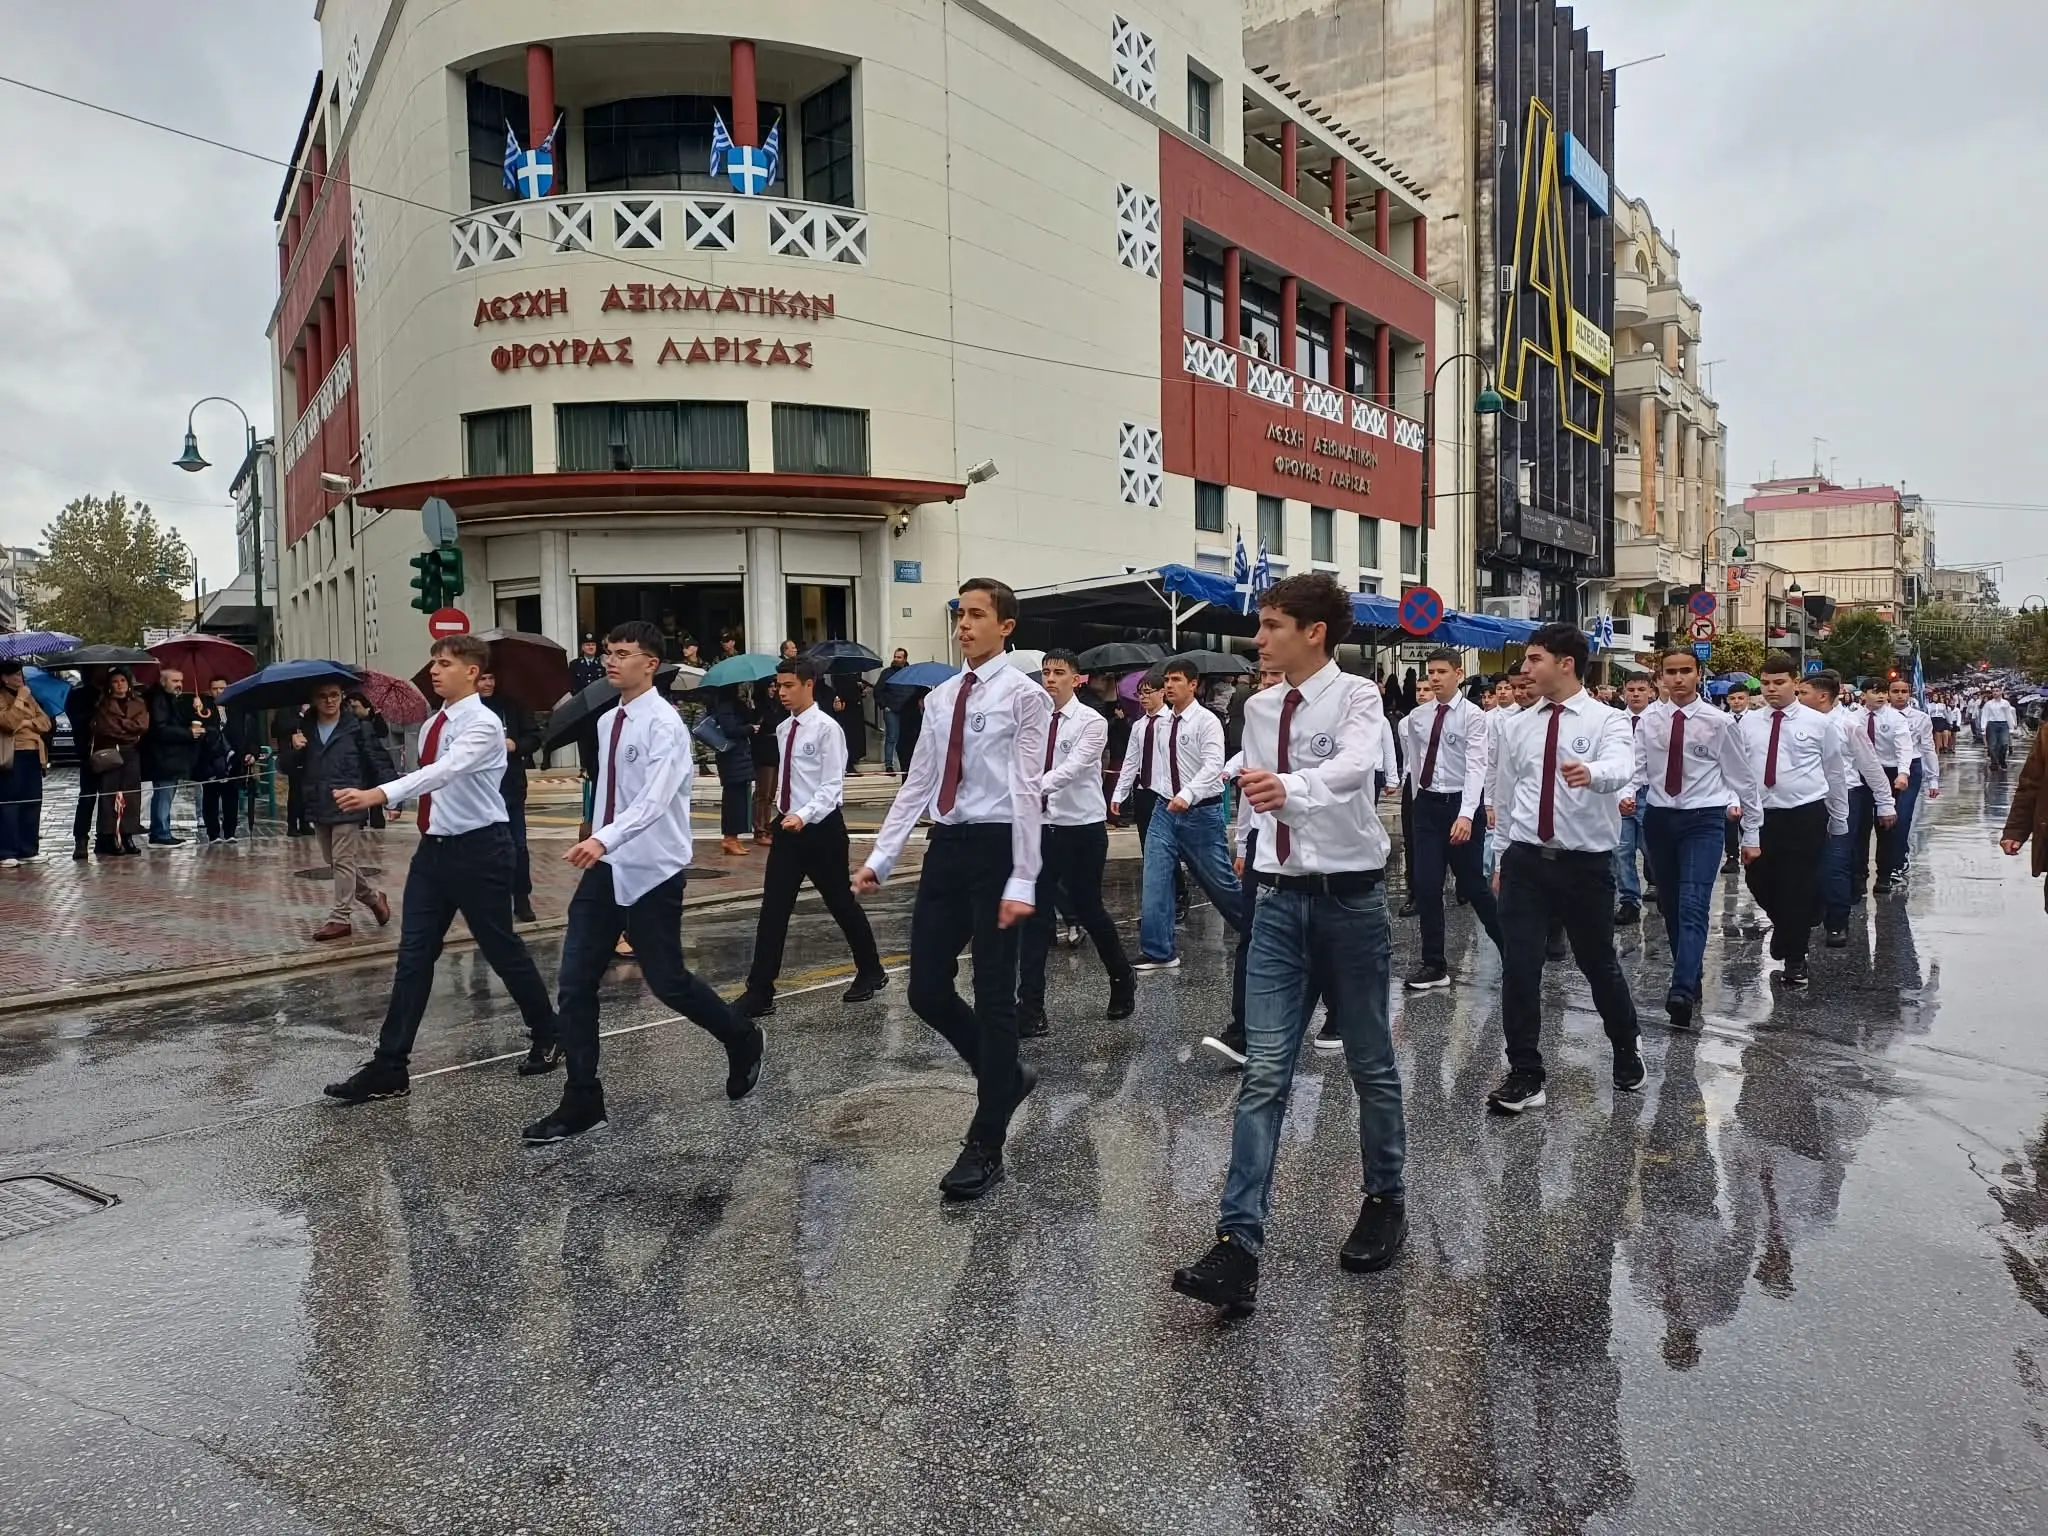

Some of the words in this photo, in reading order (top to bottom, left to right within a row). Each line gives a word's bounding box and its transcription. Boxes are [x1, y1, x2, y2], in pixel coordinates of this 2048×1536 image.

[473, 287, 568, 327] ΛΕΣΧΗ
[601, 282, 835, 321] ΑΞΙΩΜΑΤΙΚΩΝ
[490, 336, 633, 371] ΦΡΟΥΡΑΣ
[657, 336, 813, 369] ΛΑΡΙΣΑΣ
[1575, 319, 1608, 358] ALTERLIFE
[1265, 421, 1305, 449] ΛΕΣΧΗ
[1312, 436, 1379, 470] ΑΞΙΩΜΑΤΙΚΩΝ
[1274, 455, 1324, 484] ΦΡΟΥΡΑΣ
[1329, 469, 1372, 495] ΛΑΡΙΣΑΣ
